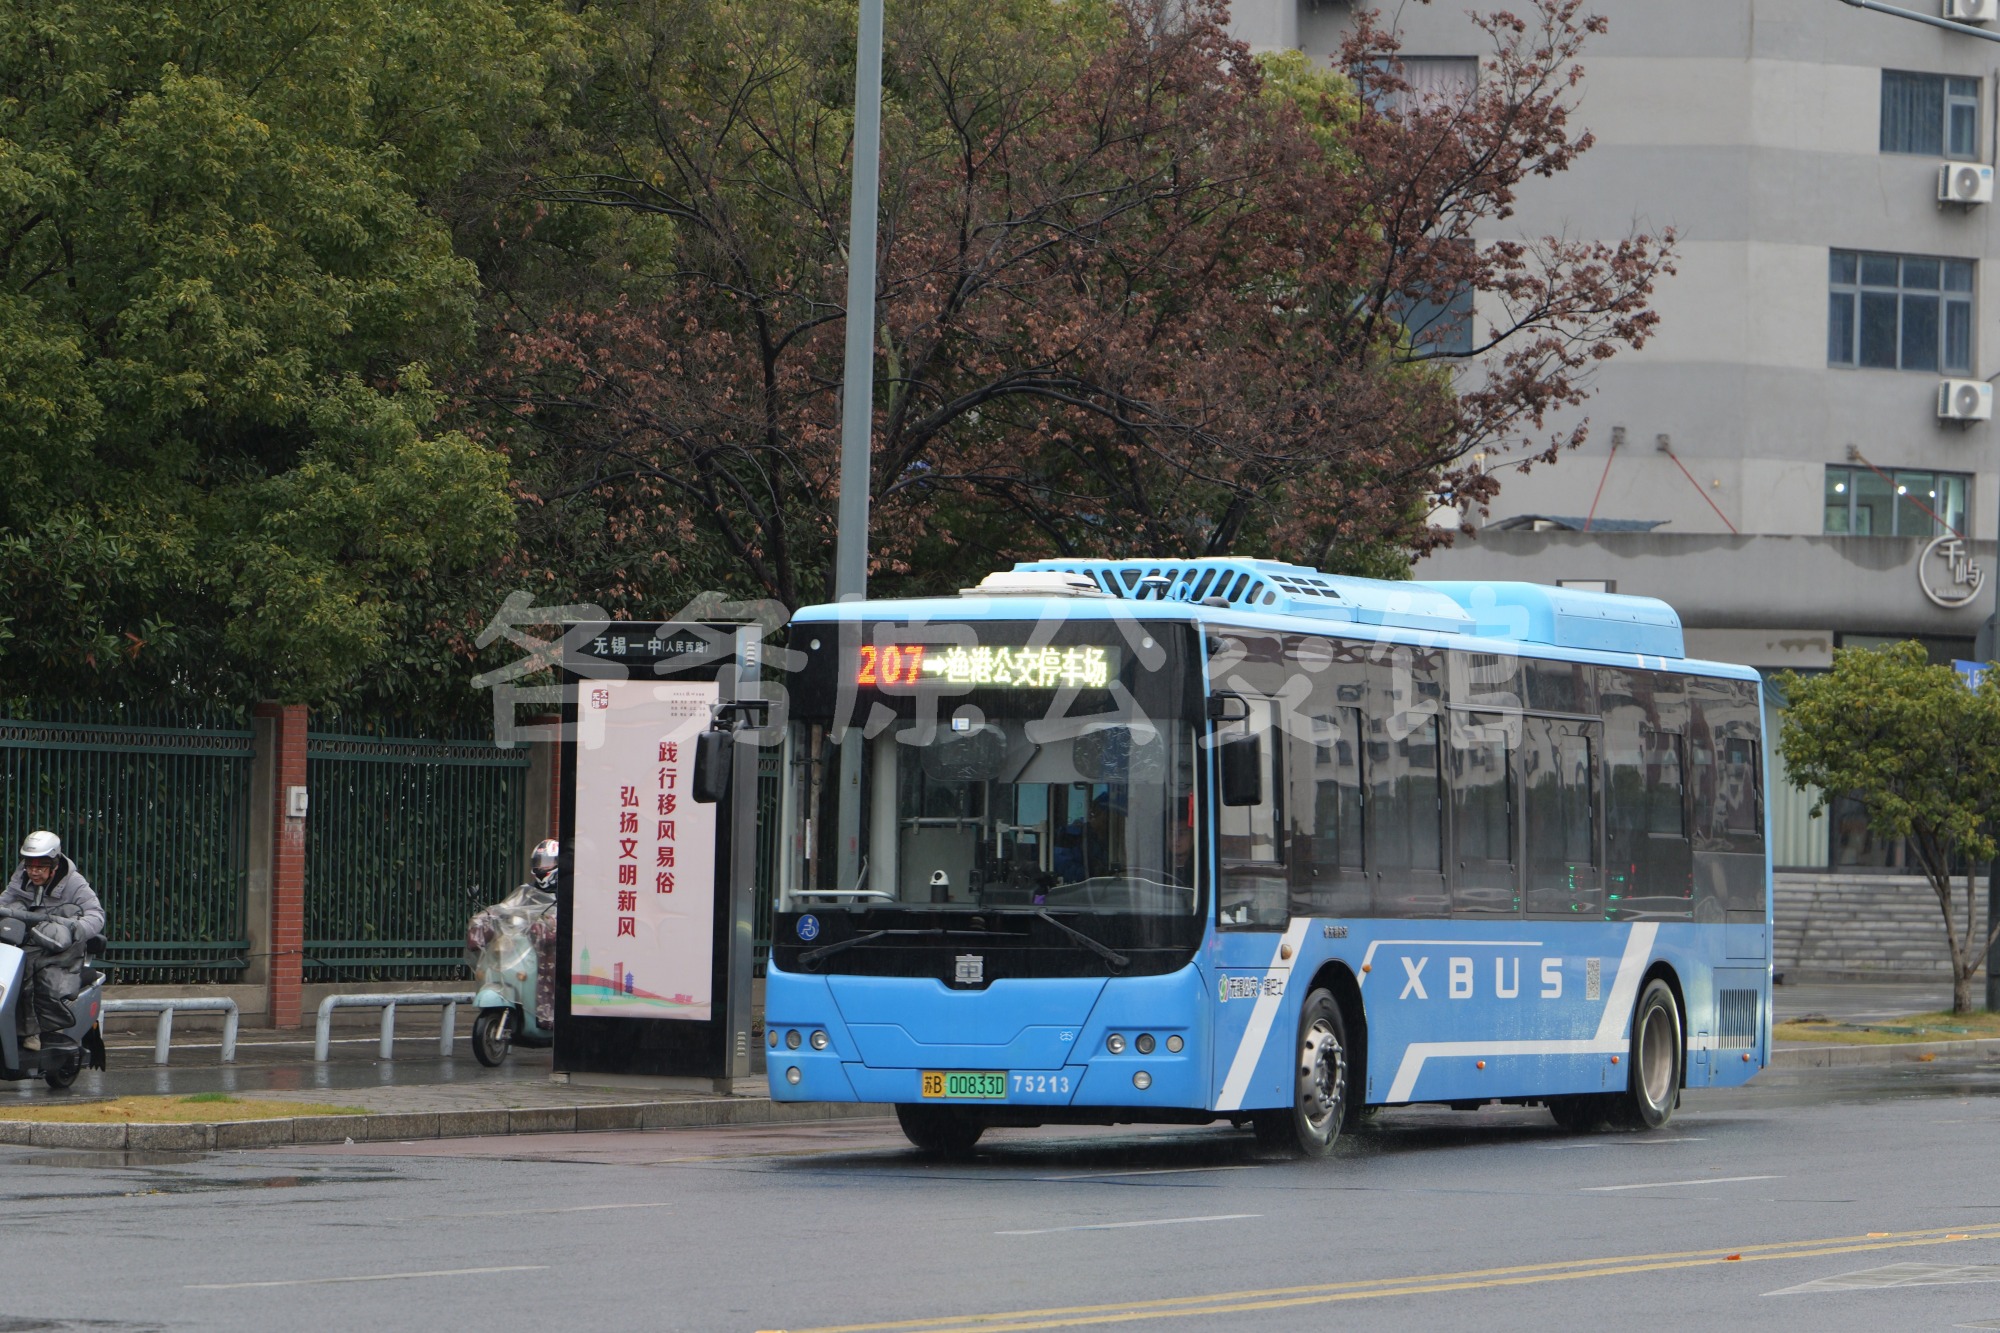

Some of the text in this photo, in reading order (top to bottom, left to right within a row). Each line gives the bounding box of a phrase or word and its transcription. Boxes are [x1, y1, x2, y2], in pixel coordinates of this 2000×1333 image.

[857, 646, 923, 684] 207
[947, 646, 1107, 686] 渔港公交停车场
[656, 741, 678, 894] 践行移风易俗
[617, 785, 639, 938] 弘扬文明新风
[1399, 957, 1563, 999] XBUS
[1013, 1075, 1070, 1093] 75213
